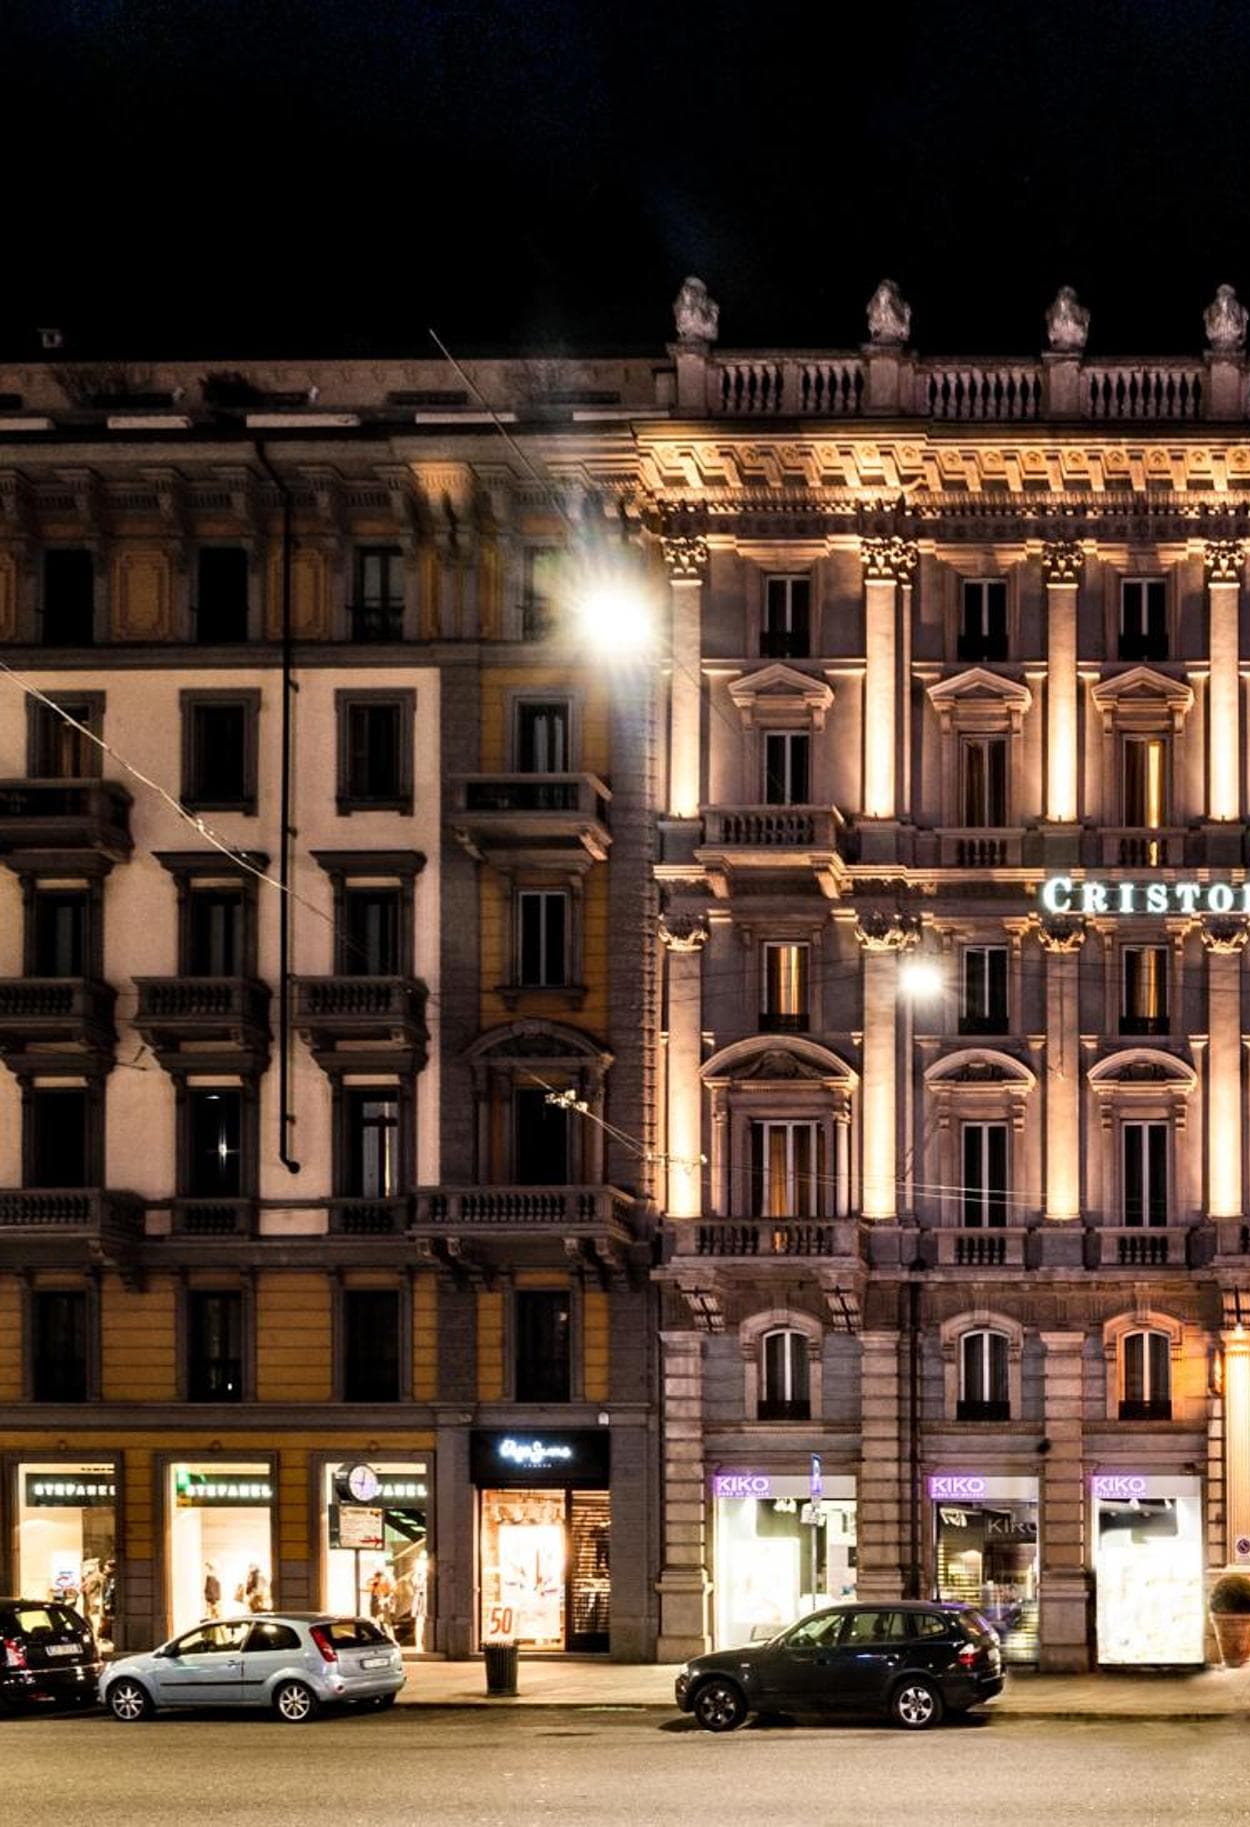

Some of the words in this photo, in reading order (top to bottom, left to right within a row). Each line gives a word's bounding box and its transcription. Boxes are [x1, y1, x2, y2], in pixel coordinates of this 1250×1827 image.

[717, 1476, 769, 1491] KIKO
[931, 1477, 985, 1493] KIKO
[1094, 1477, 1146, 1492] KIKO
[490, 1607, 513, 1634] 50
